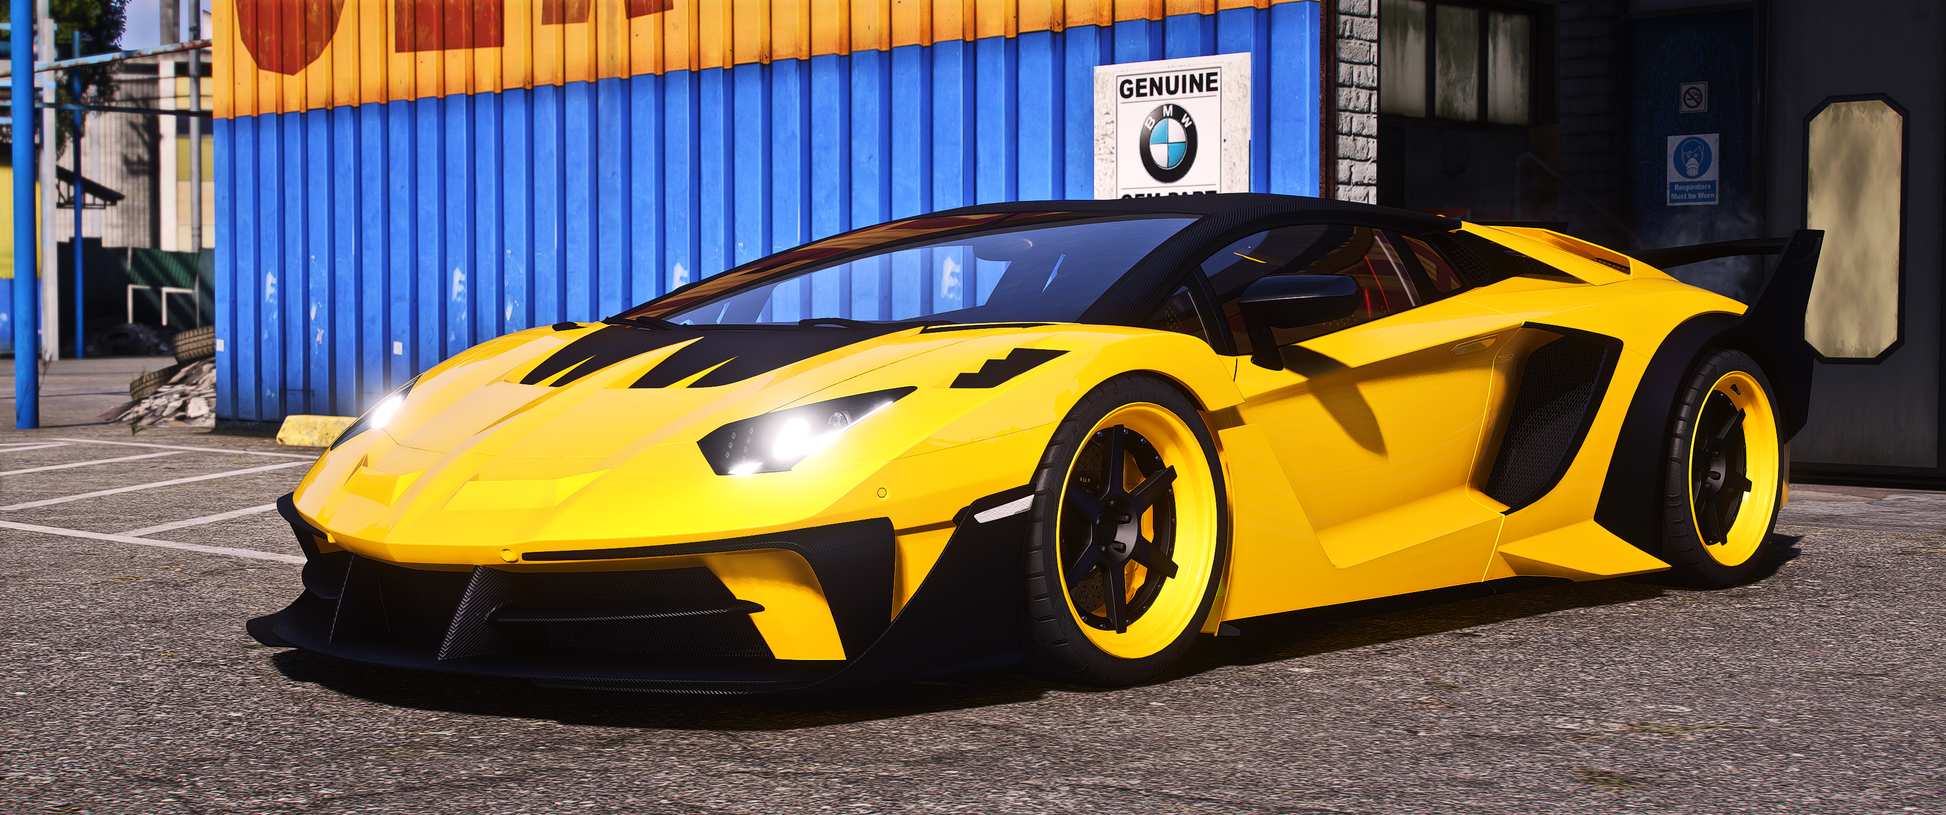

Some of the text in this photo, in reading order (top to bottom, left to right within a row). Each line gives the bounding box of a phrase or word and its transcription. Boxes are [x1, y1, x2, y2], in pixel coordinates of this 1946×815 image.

[1119, 72, 1218, 99] GENUINE
[1144, 104, 1192, 131] BMW
[1674, 184, 1711, 192] Respirators
